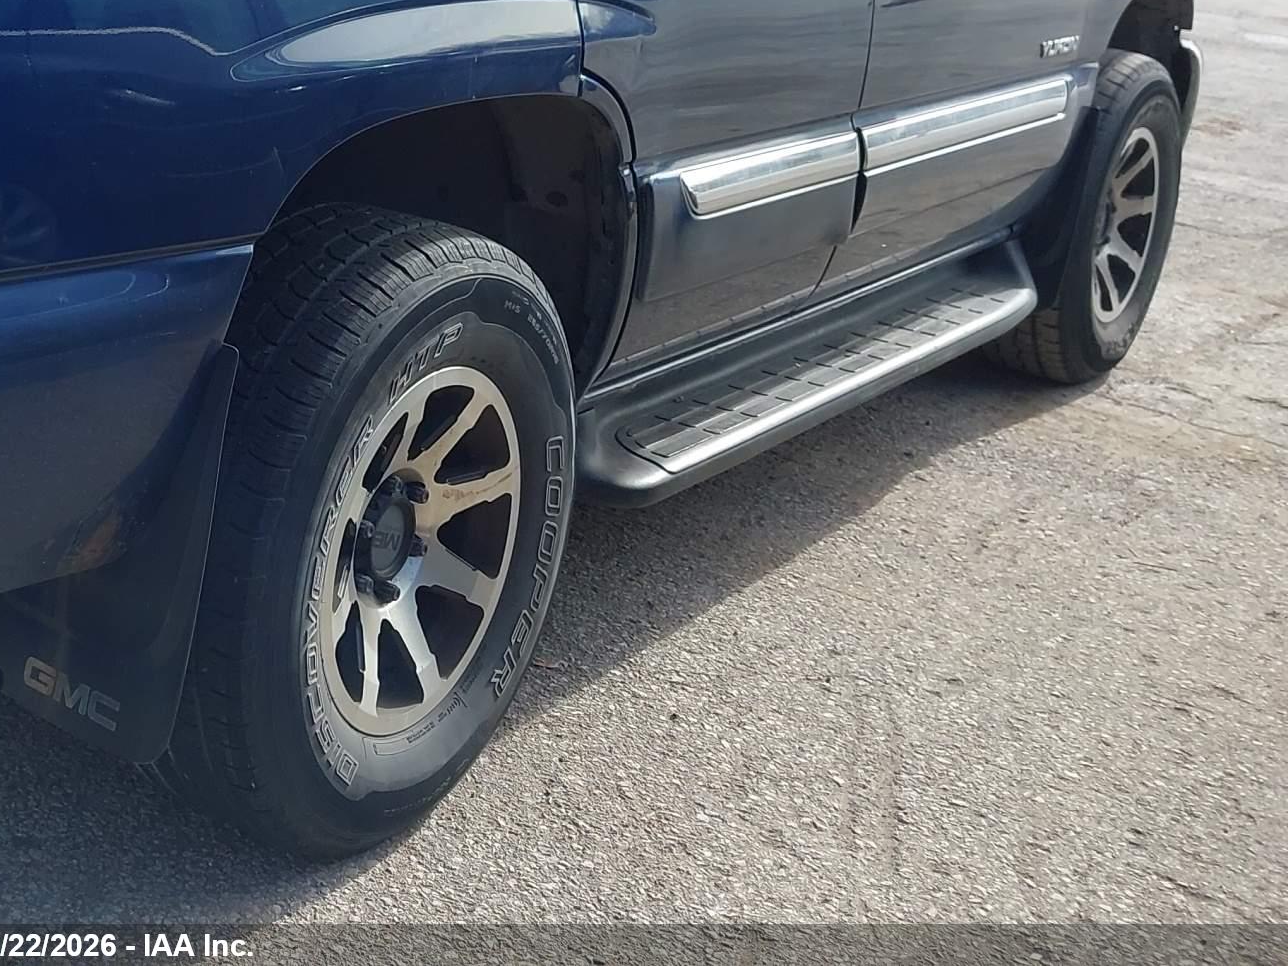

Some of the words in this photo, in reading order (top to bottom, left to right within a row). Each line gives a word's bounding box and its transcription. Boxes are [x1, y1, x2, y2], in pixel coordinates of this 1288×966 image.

[303, 414, 374, 787] DISCOVERER
[388, 322, 464, 404] HTP
[491, 435, 566, 698] COOPER
[24, 655, 121, 732] GMC
